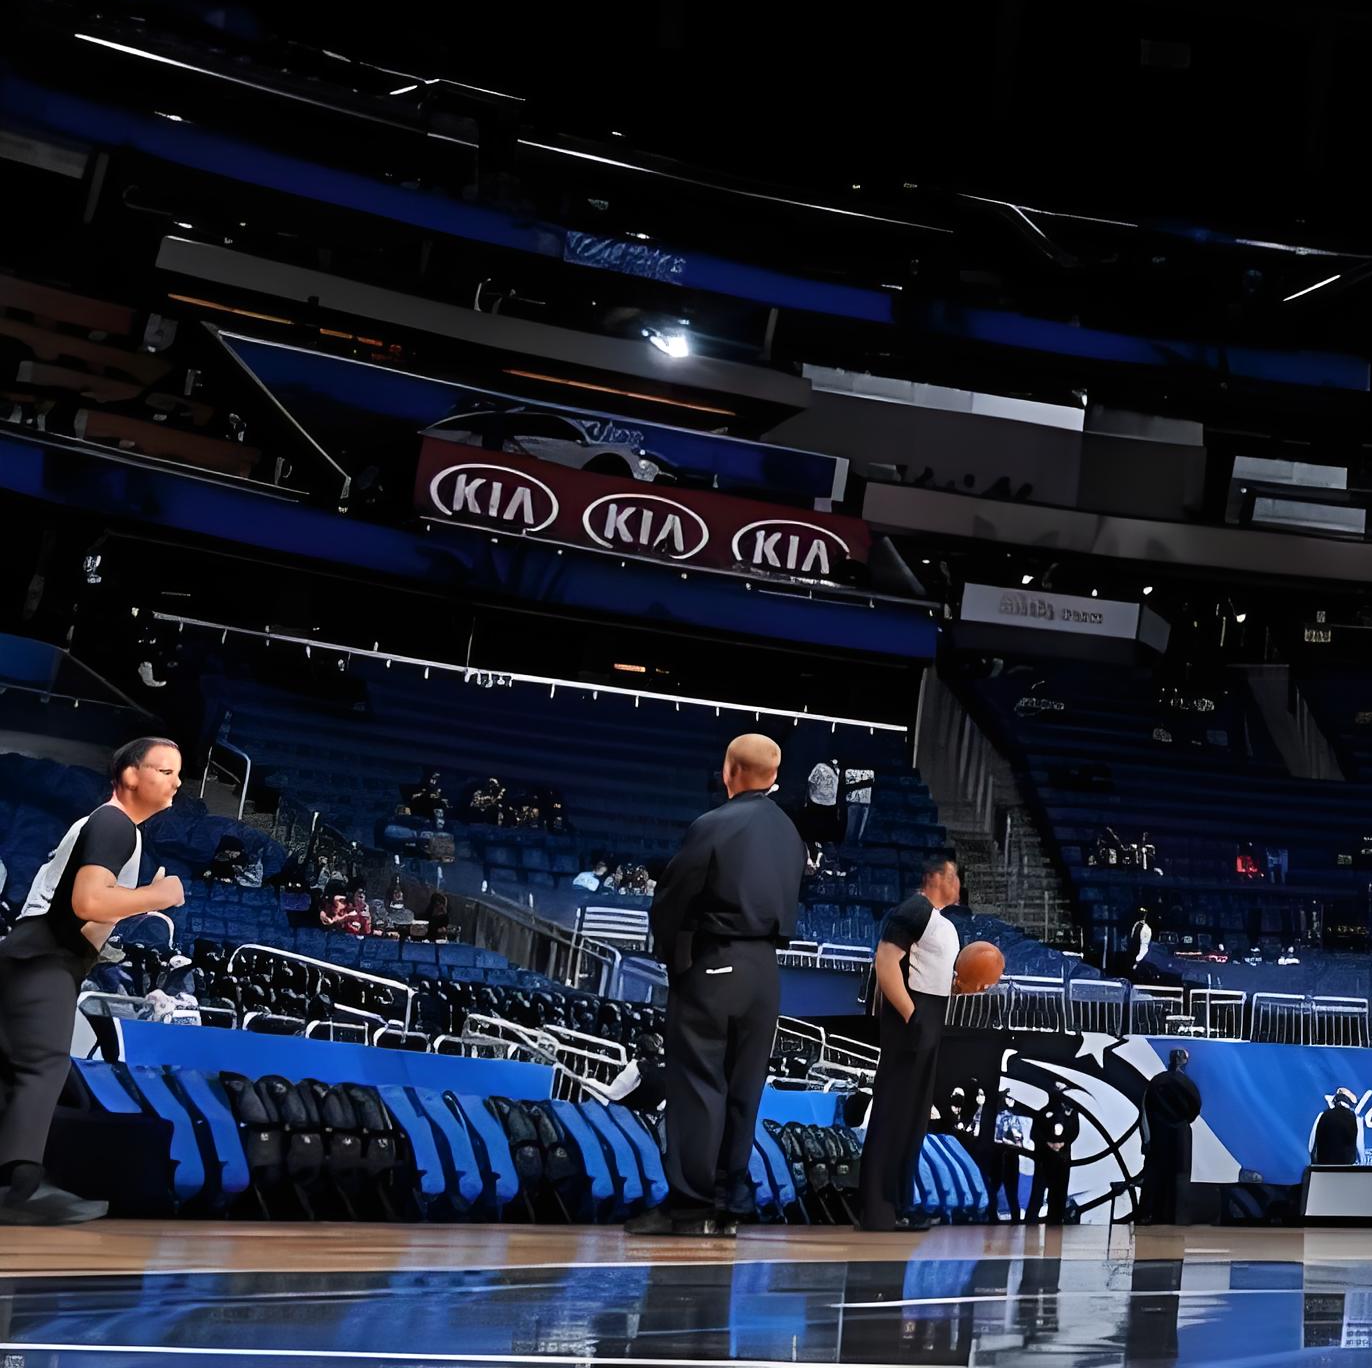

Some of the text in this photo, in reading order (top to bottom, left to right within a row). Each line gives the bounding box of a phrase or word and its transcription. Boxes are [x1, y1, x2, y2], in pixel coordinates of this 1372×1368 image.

[453, 473, 534, 525] KIA
[604, 504, 684, 552] KIA
[752, 530, 830, 574] KIA
